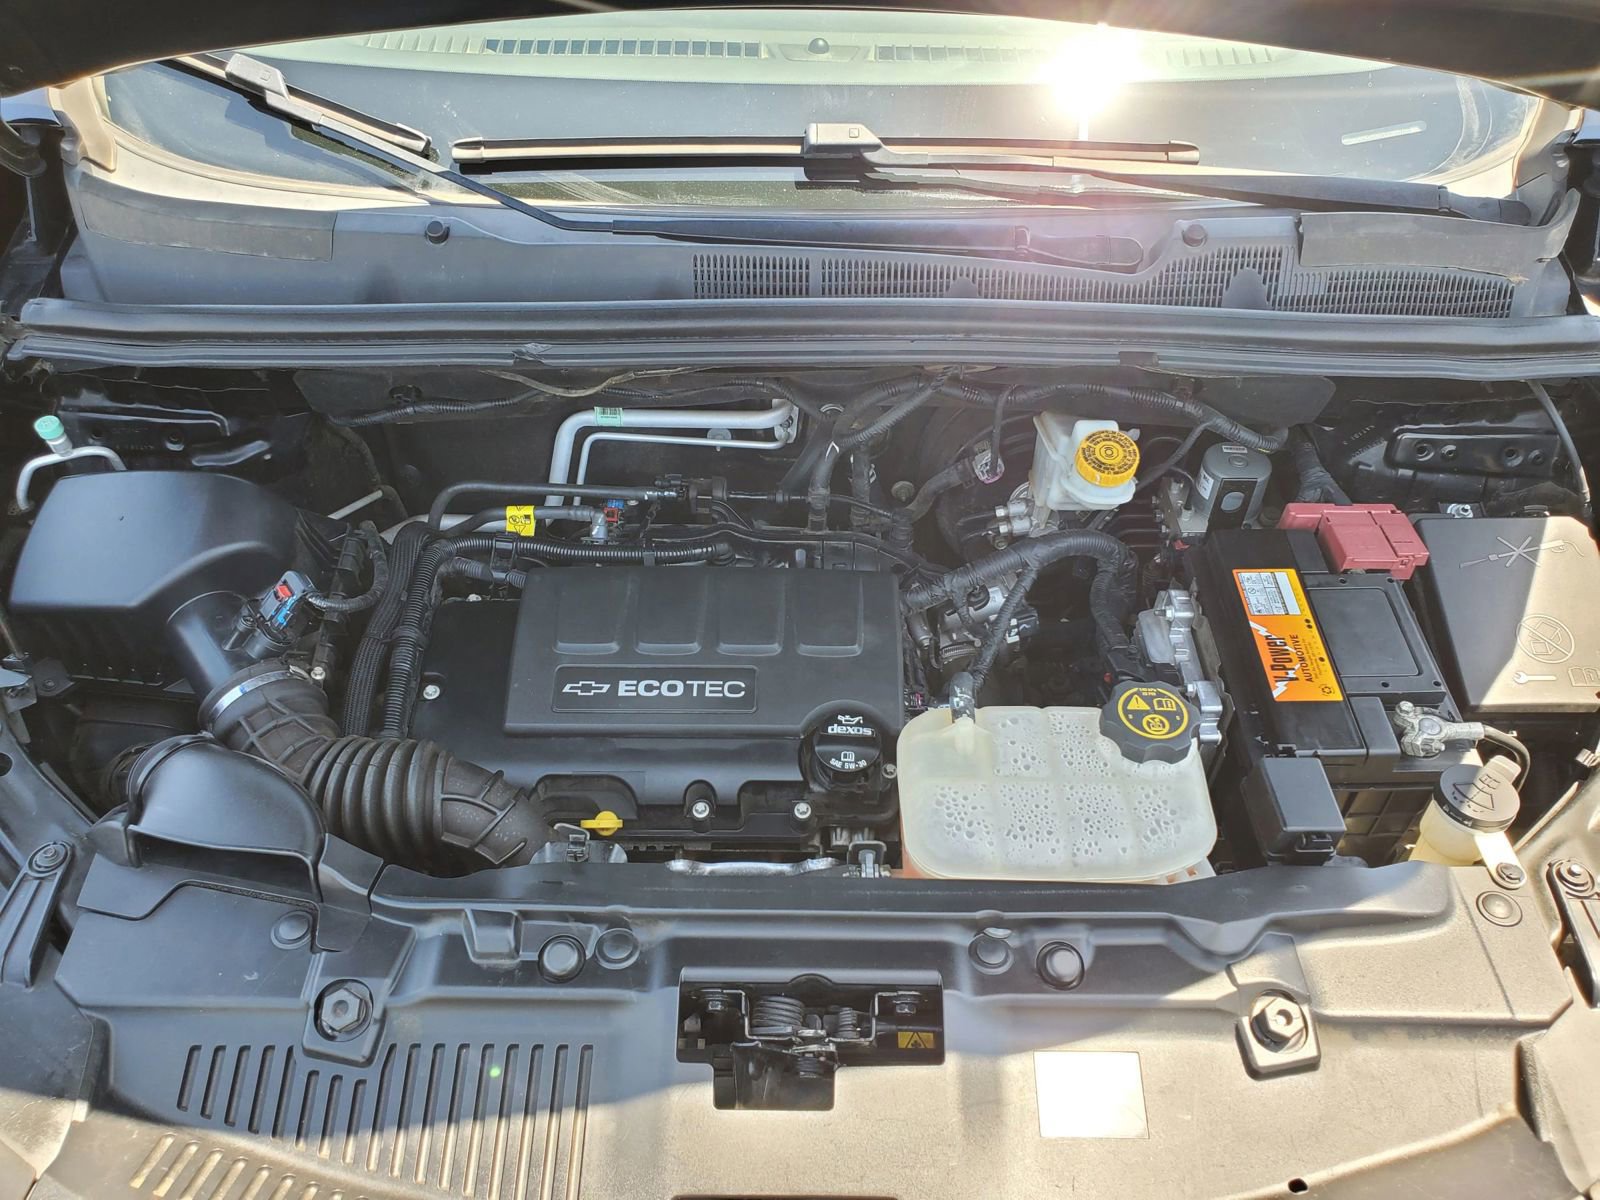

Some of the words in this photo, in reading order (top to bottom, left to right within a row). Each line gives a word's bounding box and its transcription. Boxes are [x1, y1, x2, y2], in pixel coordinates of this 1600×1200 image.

[1290, 634, 1314, 682] AUTOMOTIVE
[617, 679, 746, 698] ECOTEC
[827, 723, 872, 736] dexos
[829, 758, 842, 768] SAE
